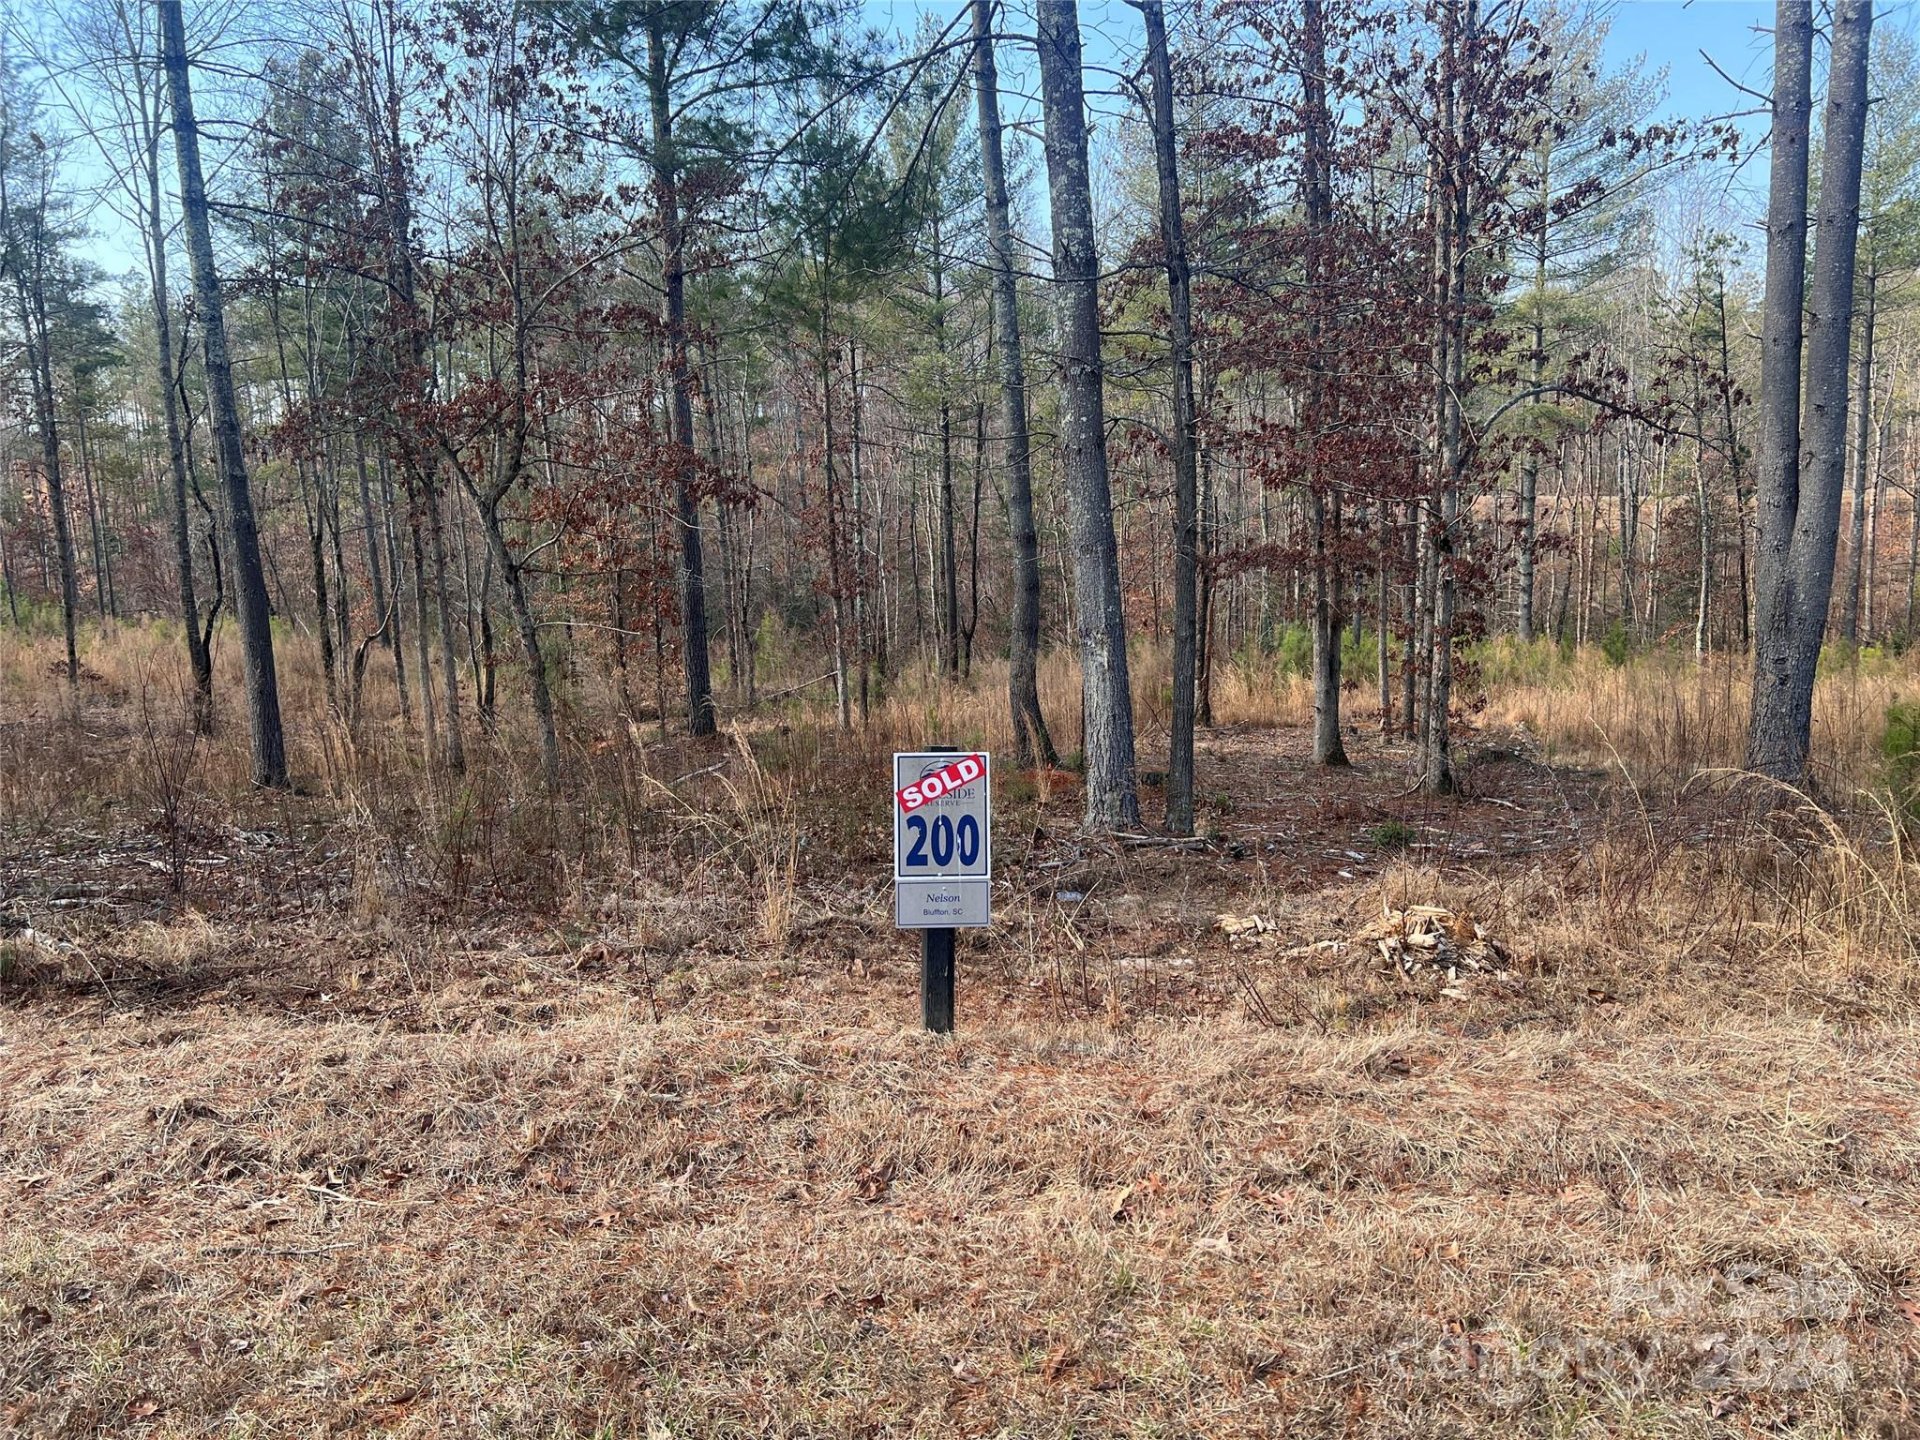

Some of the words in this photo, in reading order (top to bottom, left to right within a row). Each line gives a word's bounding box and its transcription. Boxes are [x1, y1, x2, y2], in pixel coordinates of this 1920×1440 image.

[903, 759, 979, 807] SOLD
[906, 814, 979, 866] 200
[926, 893, 961, 903] Nelson
[952, 908, 964, 916] SC
